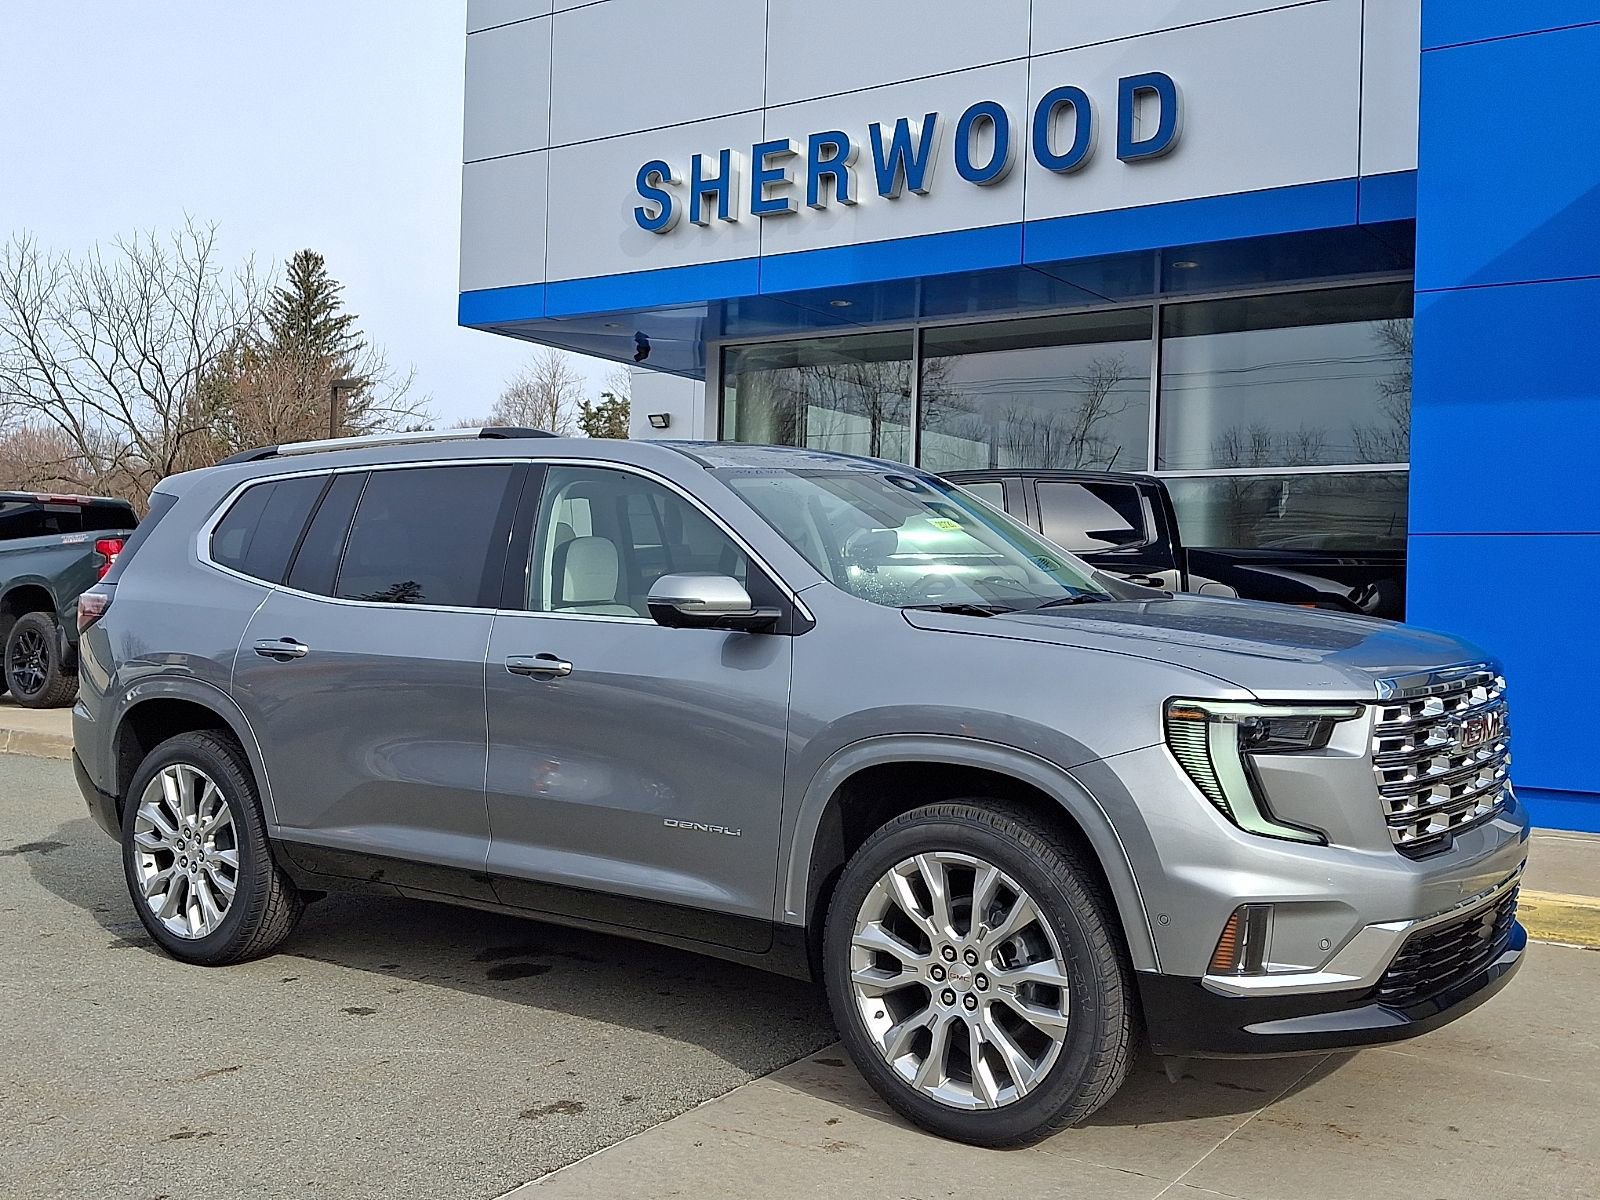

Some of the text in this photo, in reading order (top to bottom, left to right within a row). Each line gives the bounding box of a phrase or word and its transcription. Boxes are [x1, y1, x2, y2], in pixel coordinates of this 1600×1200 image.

[634, 71, 1183, 232] SHERWOOD
[663, 818, 742, 837] DENALI
[949, 972, 970, 983] GMC
